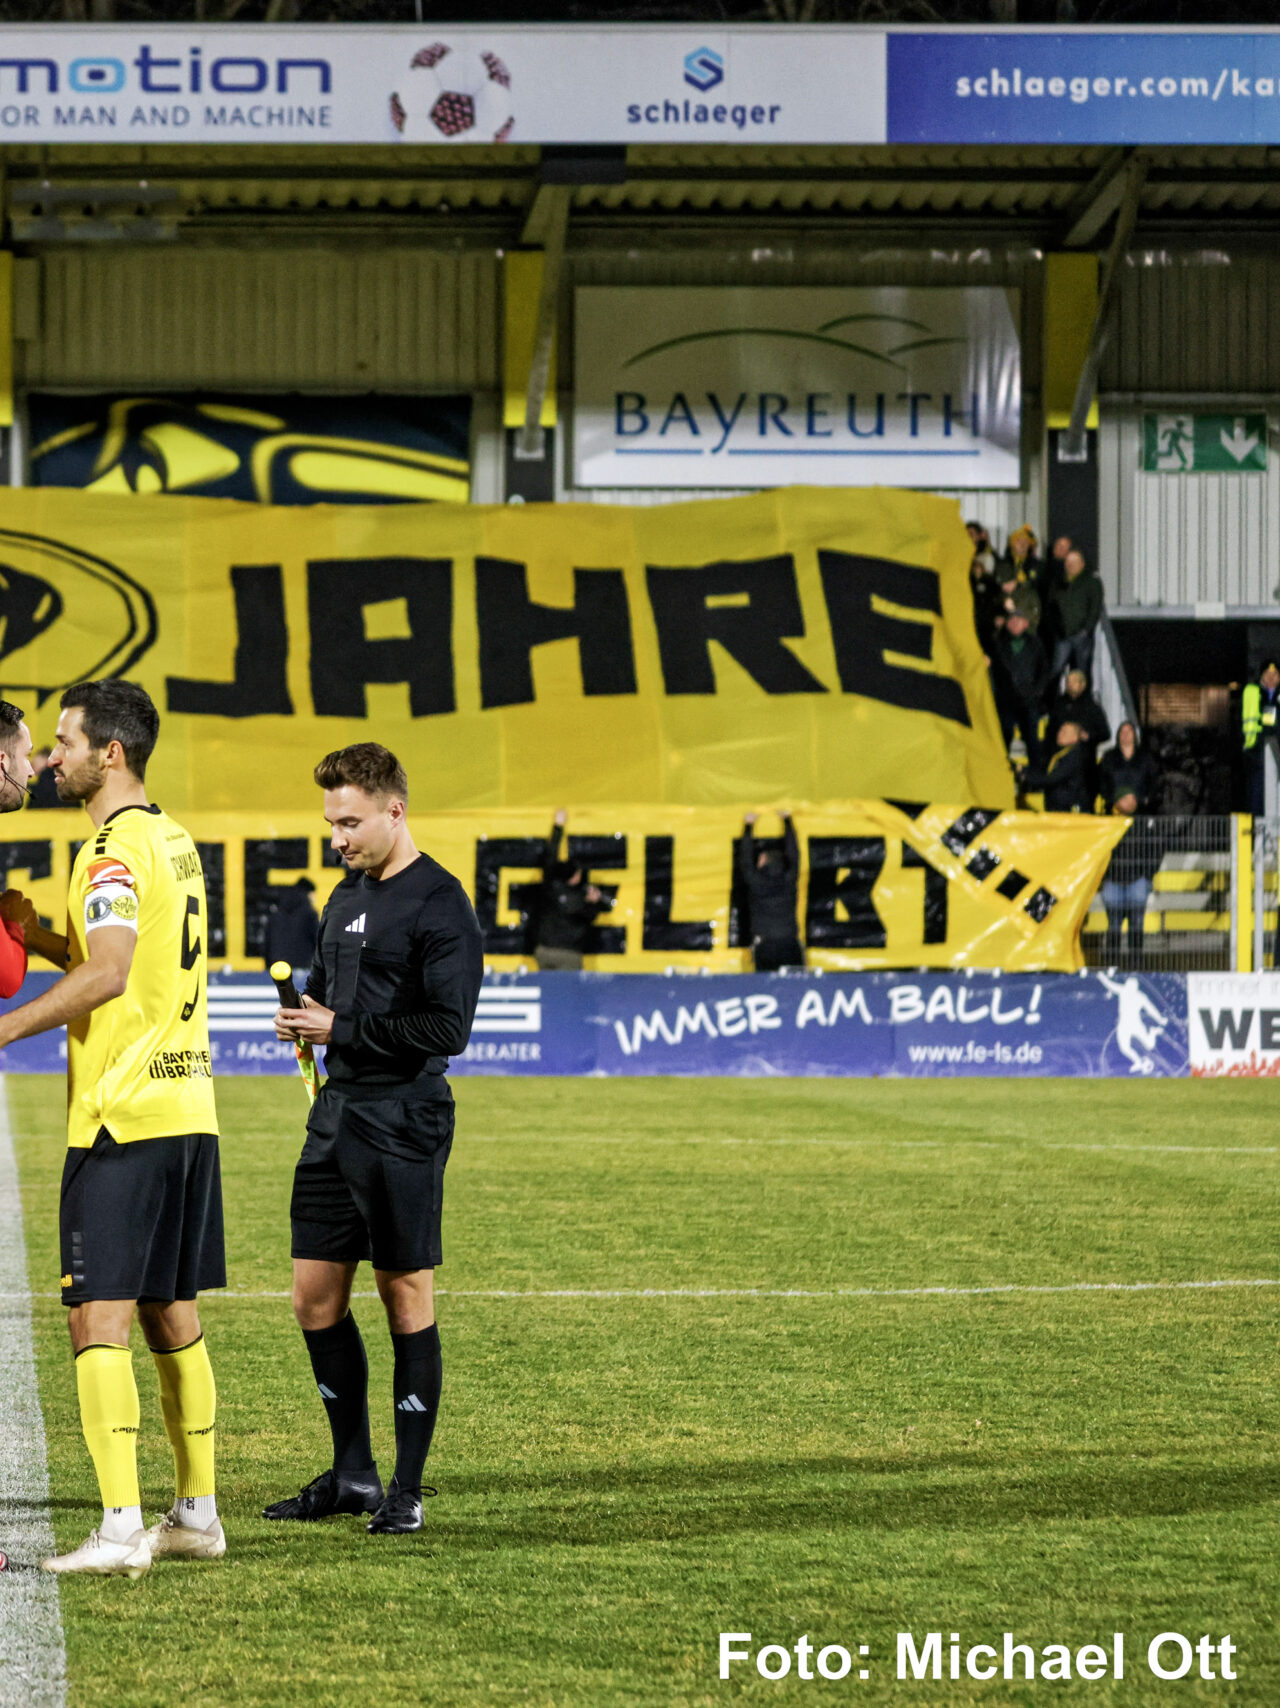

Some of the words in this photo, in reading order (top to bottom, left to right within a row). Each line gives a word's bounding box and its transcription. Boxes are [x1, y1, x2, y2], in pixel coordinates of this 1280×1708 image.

[956, 68, 1280, 104] schlaeger.com/ka
[54, 105, 117, 126] MAN
[130, 105, 191, 126] AND
[205, 105, 333, 126] MACHINE
[627, 99, 782, 130] schlaeger
[615, 391, 981, 455] BAYREUTH
[165, 547, 973, 729] JAHRE
[615, 994, 782, 1055] IMMER
[796, 988, 873, 1028] AM
[887, 984, 1042, 1025] BALL!
[908, 1041, 1043, 1064] www.fe-ls.de
